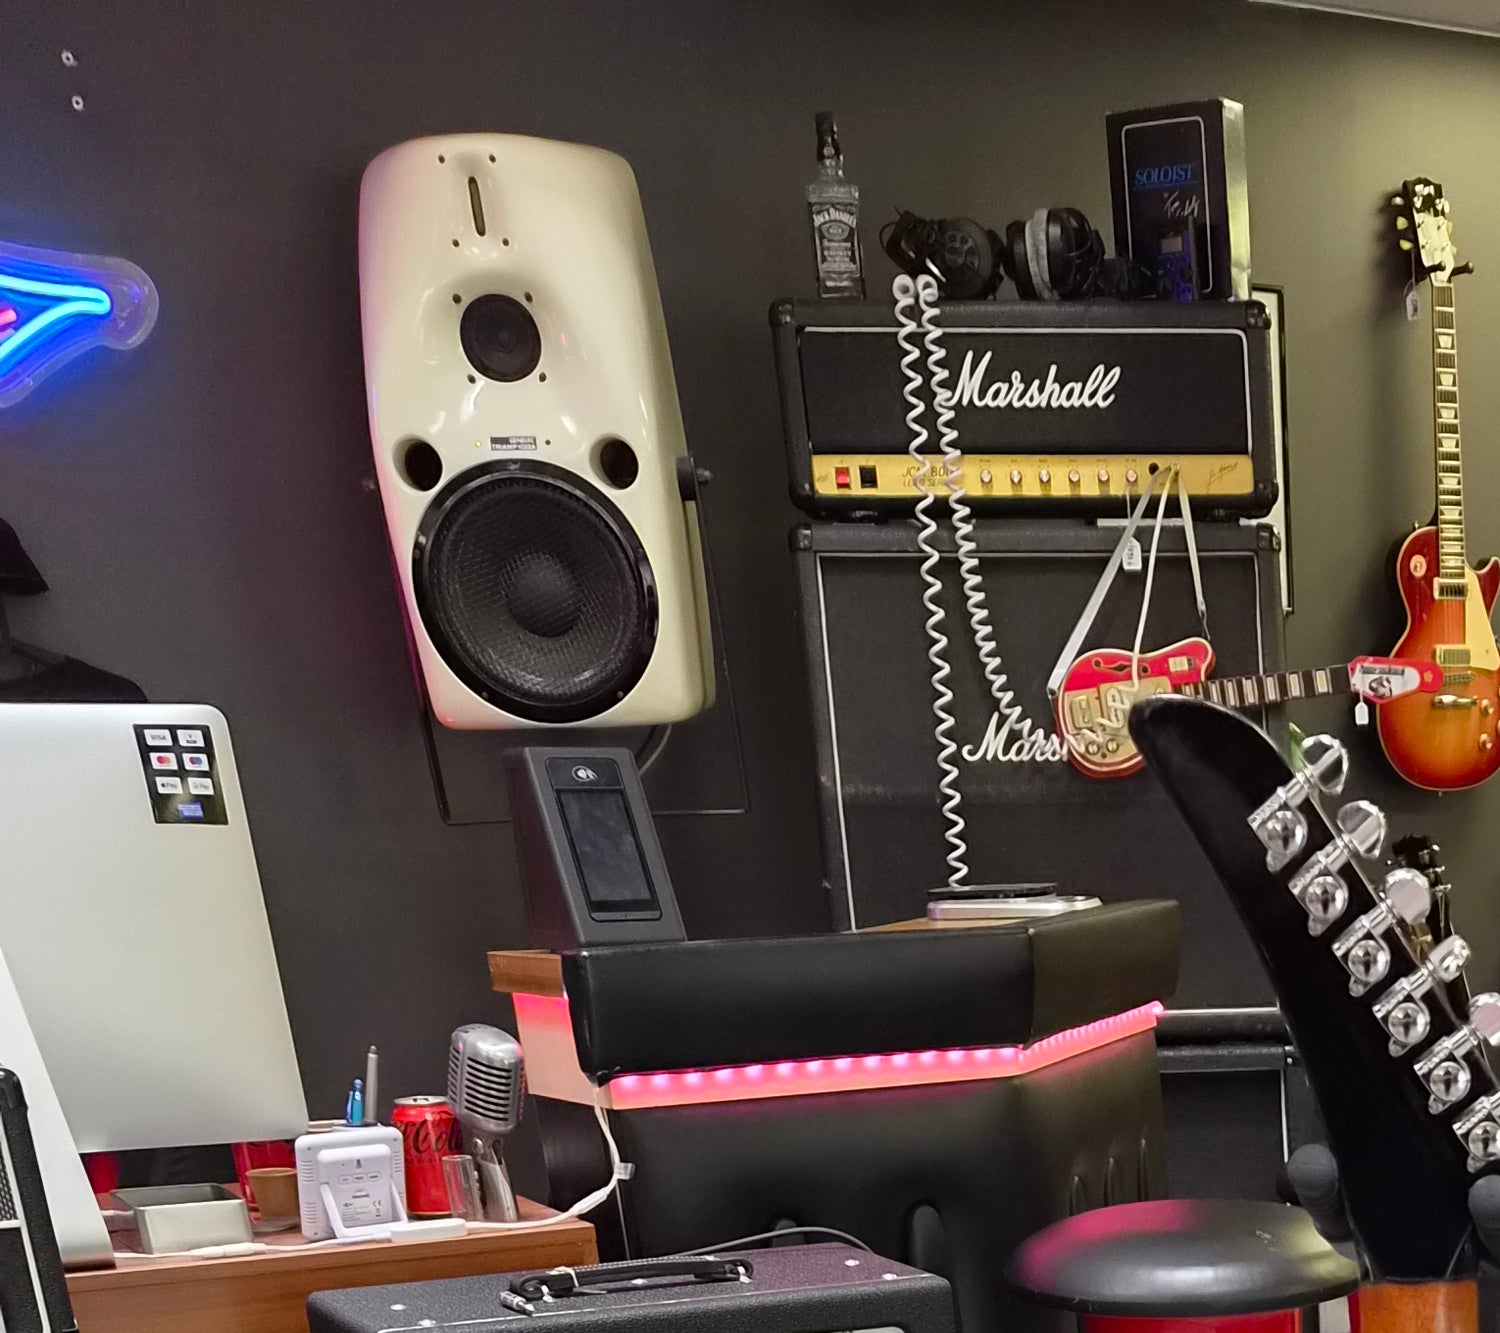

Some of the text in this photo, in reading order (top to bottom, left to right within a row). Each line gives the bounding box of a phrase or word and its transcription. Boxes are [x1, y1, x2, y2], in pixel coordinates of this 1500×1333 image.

[1135, 164, 1191, 185] SOLOIST
[941, 350, 1121, 408] Marshall
[962, 711, 1068, 762] Mars
